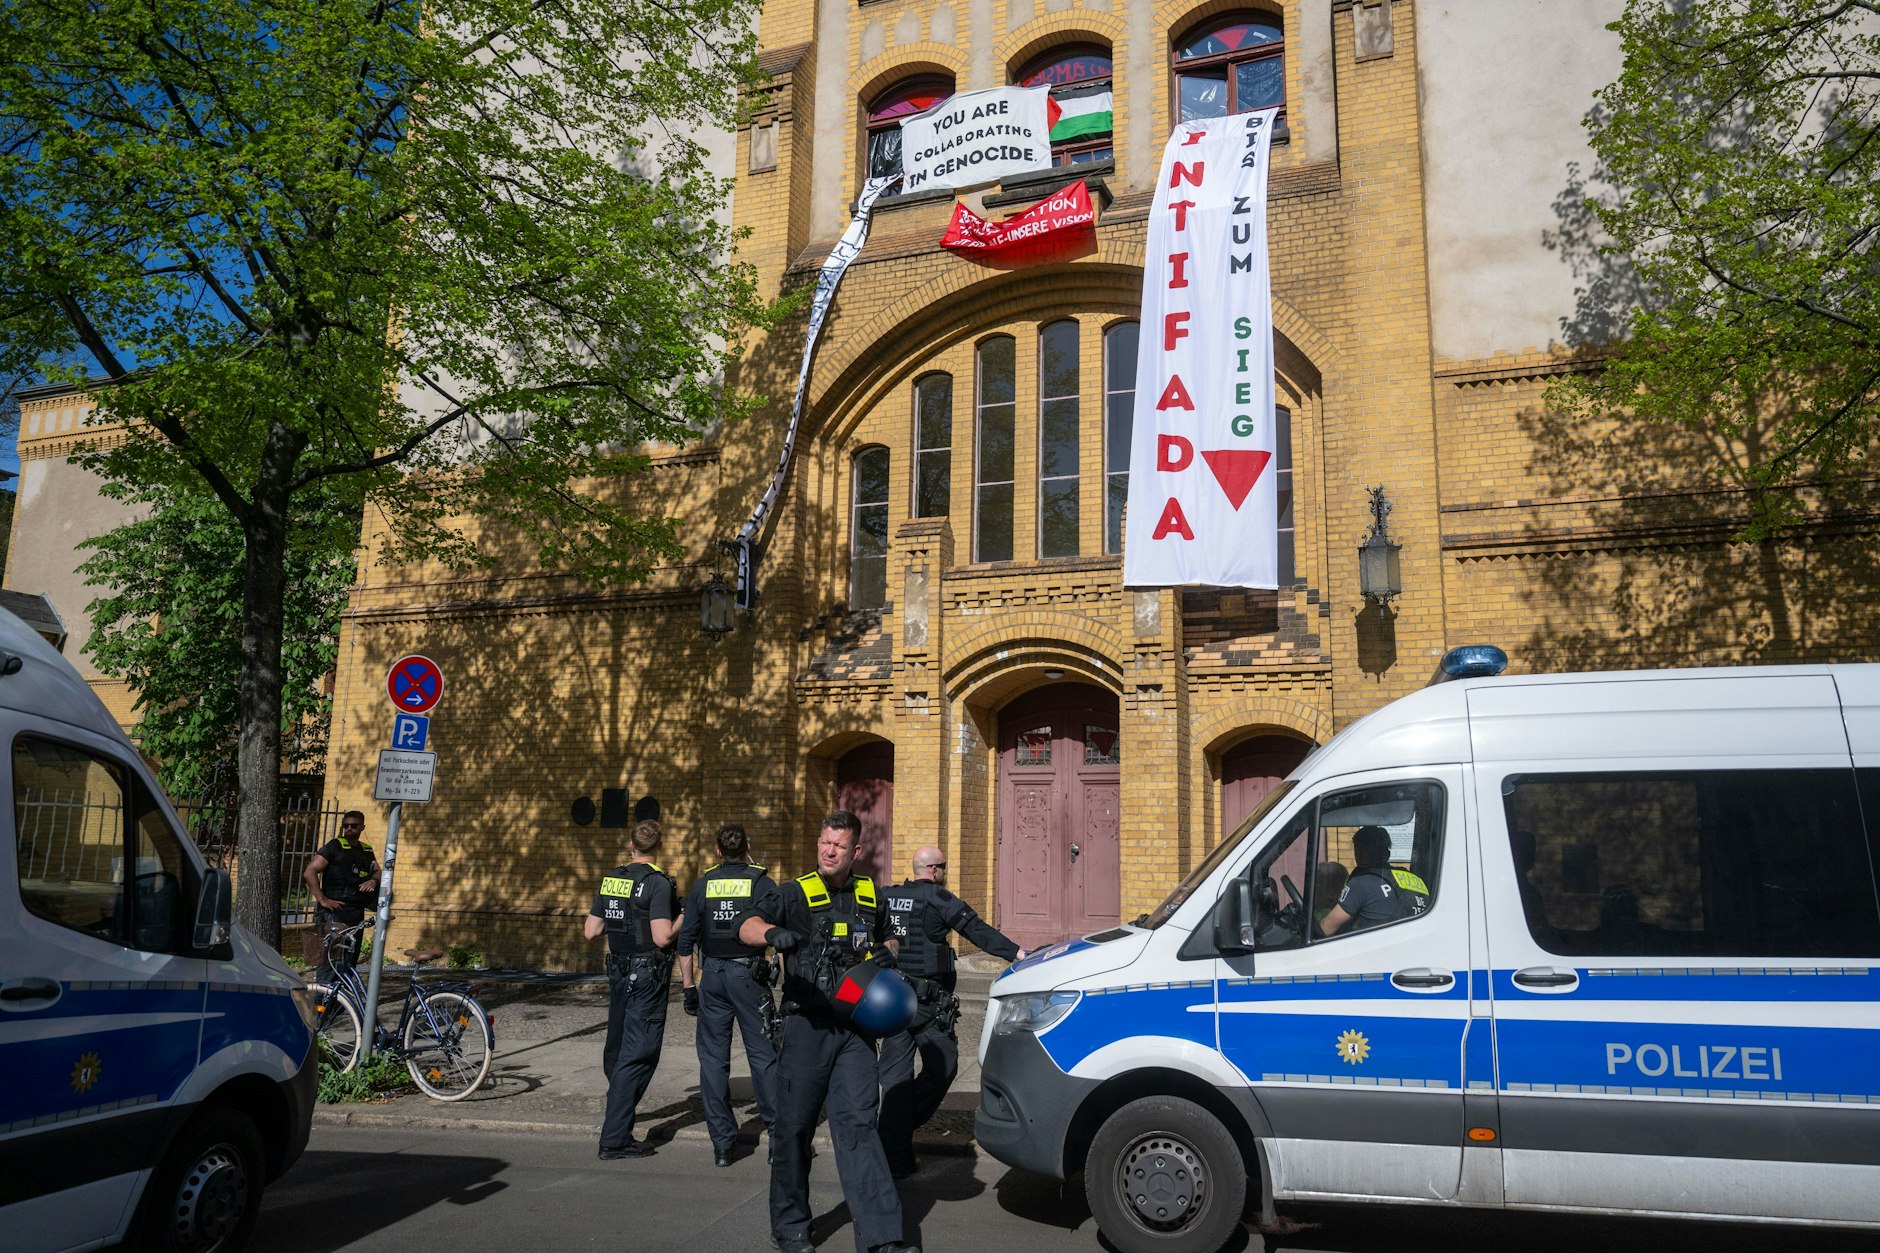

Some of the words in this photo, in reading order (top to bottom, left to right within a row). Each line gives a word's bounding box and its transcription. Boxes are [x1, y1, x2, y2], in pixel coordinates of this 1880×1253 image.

[933, 110, 965, 134] YOU
[972, 100, 1008, 120] ARE
[914, 124, 1032, 162] COLLABORATING
[1241, 117, 1263, 168] BIS
[909, 169, 927, 188] IN
[933, 145, 1038, 177] GENOCIDE.
[1052, 211, 1094, 229] VISION
[1231, 196, 1252, 274] ZUM
[1152, 131, 1206, 540] INTIFADA
[1231, 317, 1254, 437] SIEG
[398, 718, 418, 745] P
[380, 766, 431, 775] Bewohnerparkausweis
[602, 878, 632, 897] POLIZEI
[707, 880, 750, 897] POLIZEI
[605, 909, 624, 919] 25129
[609, 900, 618, 909] BE
[720, 901, 733, 910] BE
[1605, 1042, 1783, 1081] POLIZEI
